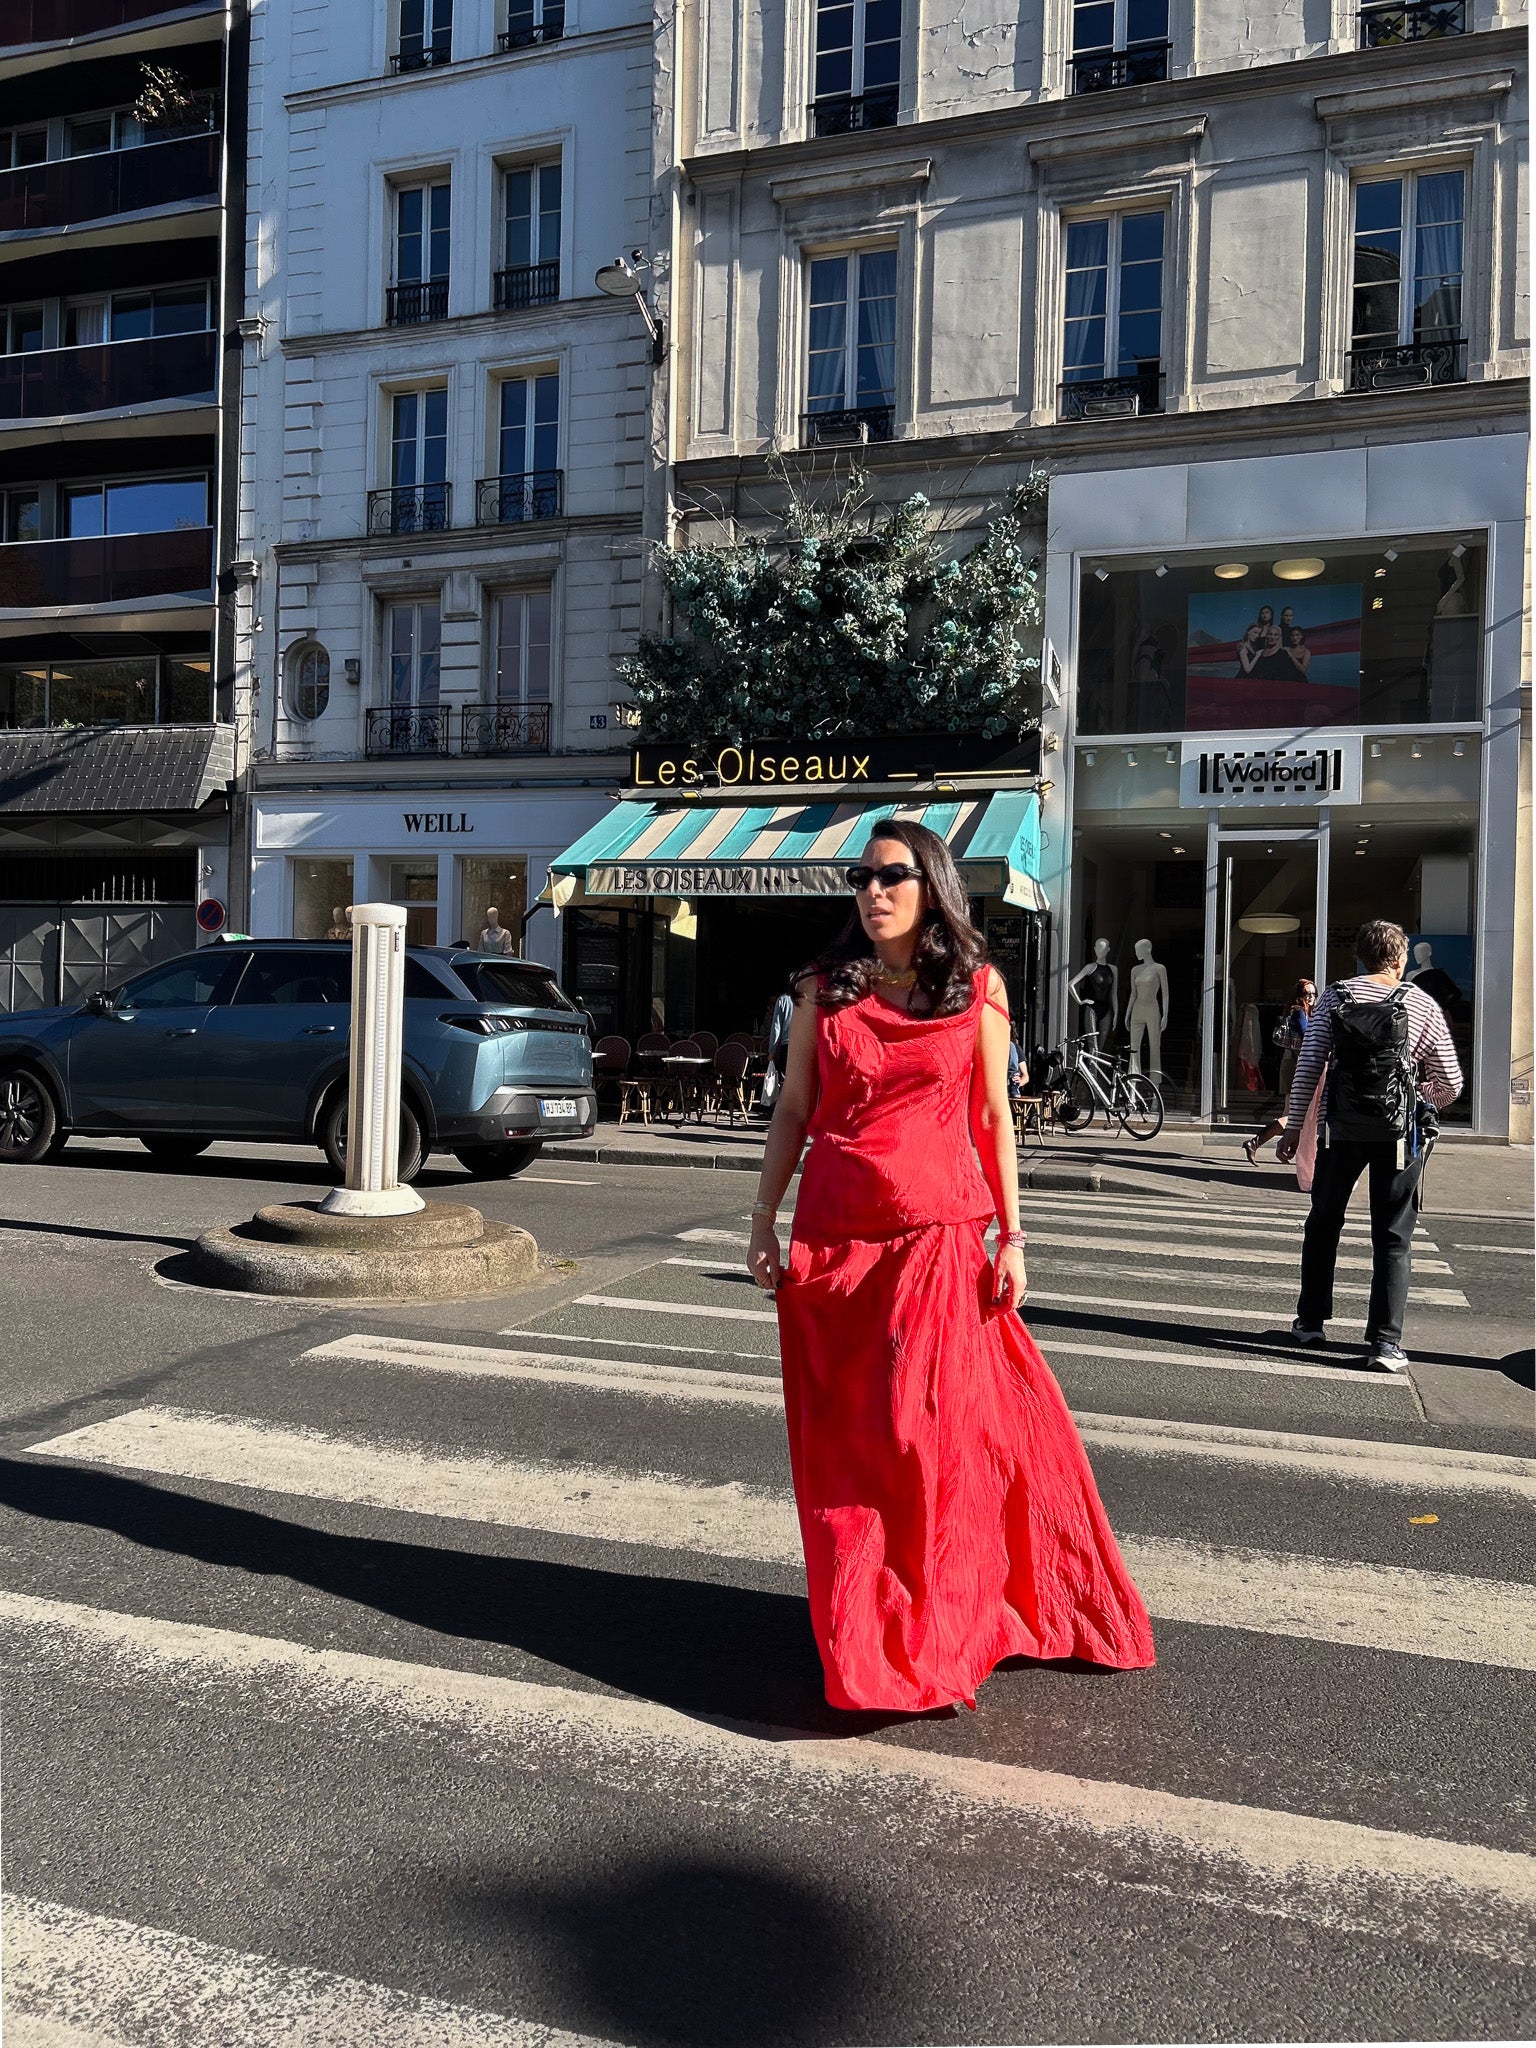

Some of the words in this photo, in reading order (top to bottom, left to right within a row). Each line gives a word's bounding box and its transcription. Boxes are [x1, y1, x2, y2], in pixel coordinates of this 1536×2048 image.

[591, 716, 605, 728] 43
[635, 751, 698, 785] Les
[1223, 760, 1317, 783] Wolford
[402, 813, 475, 833] WEILL
[613, 870, 648, 891] LES
[652, 869, 751, 891] OISEAUX
